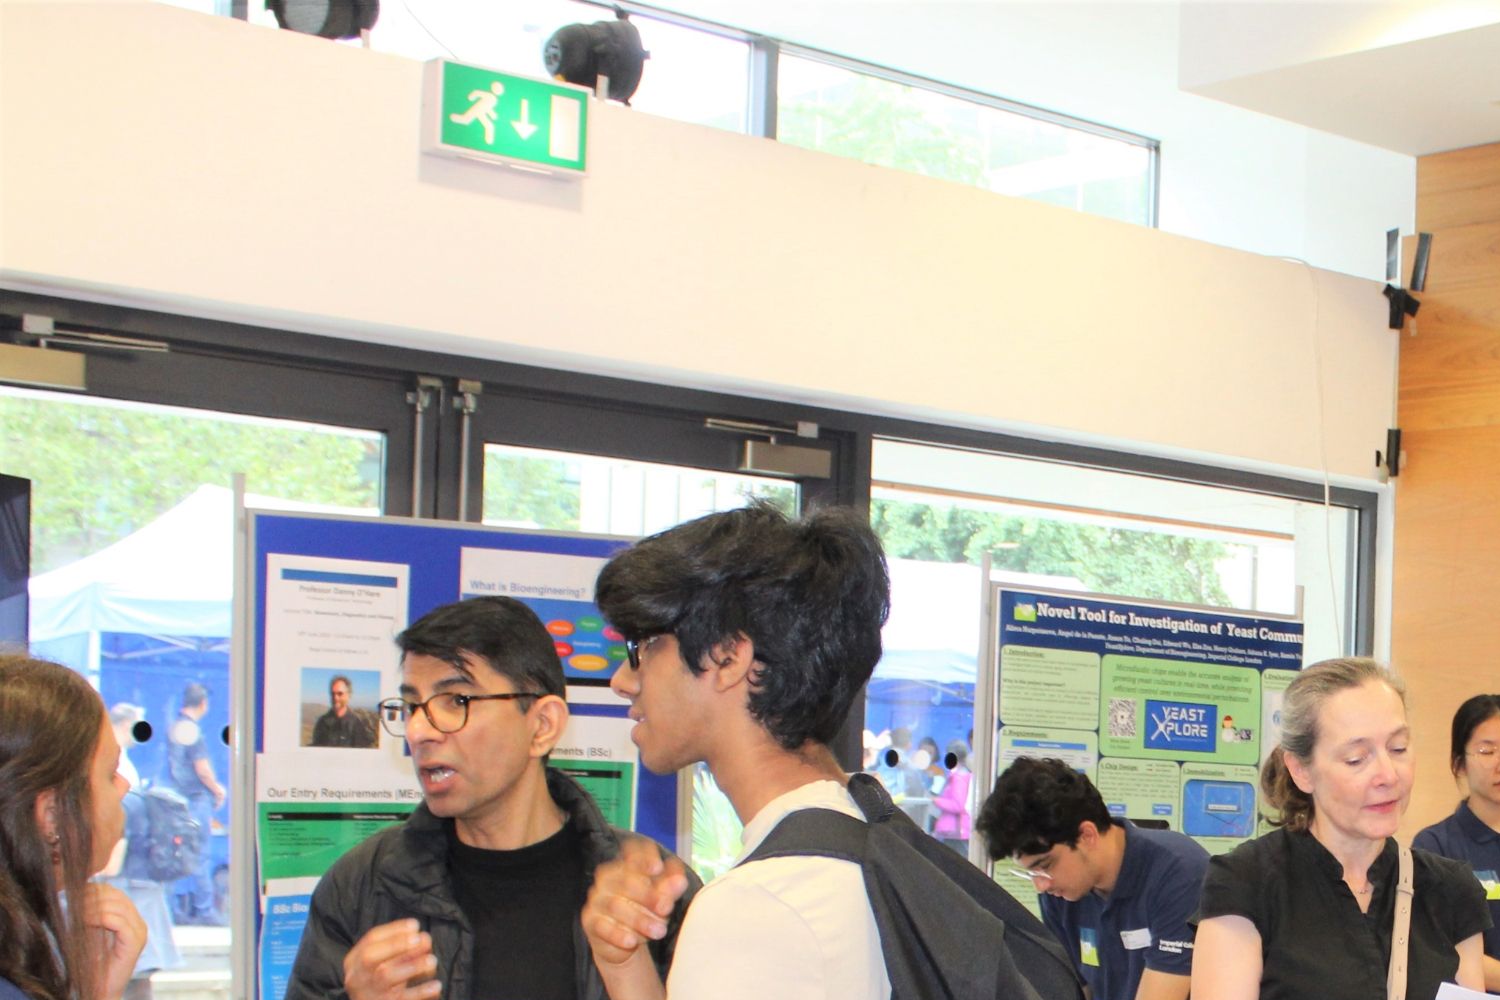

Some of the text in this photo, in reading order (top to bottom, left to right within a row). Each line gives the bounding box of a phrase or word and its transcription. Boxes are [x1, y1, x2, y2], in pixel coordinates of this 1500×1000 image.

[469, 580, 495, 591] What
[510, 582, 586, 598] Bioengineering?
[1036, 602, 1076, 620] Novel
[1078, 607, 1107, 623] Tool
[1109, 610, 1127, 625] for
[1128, 612, 1209, 634] Investigation
[1210, 622, 1223, 635] of
[1225, 623, 1258, 640] Yeast
[1162, 706, 1206, 721] YEAST
[267, 788, 288, 798] Our
[290, 788, 317, 799] Entry
[320, 788, 392, 799] Requirements
